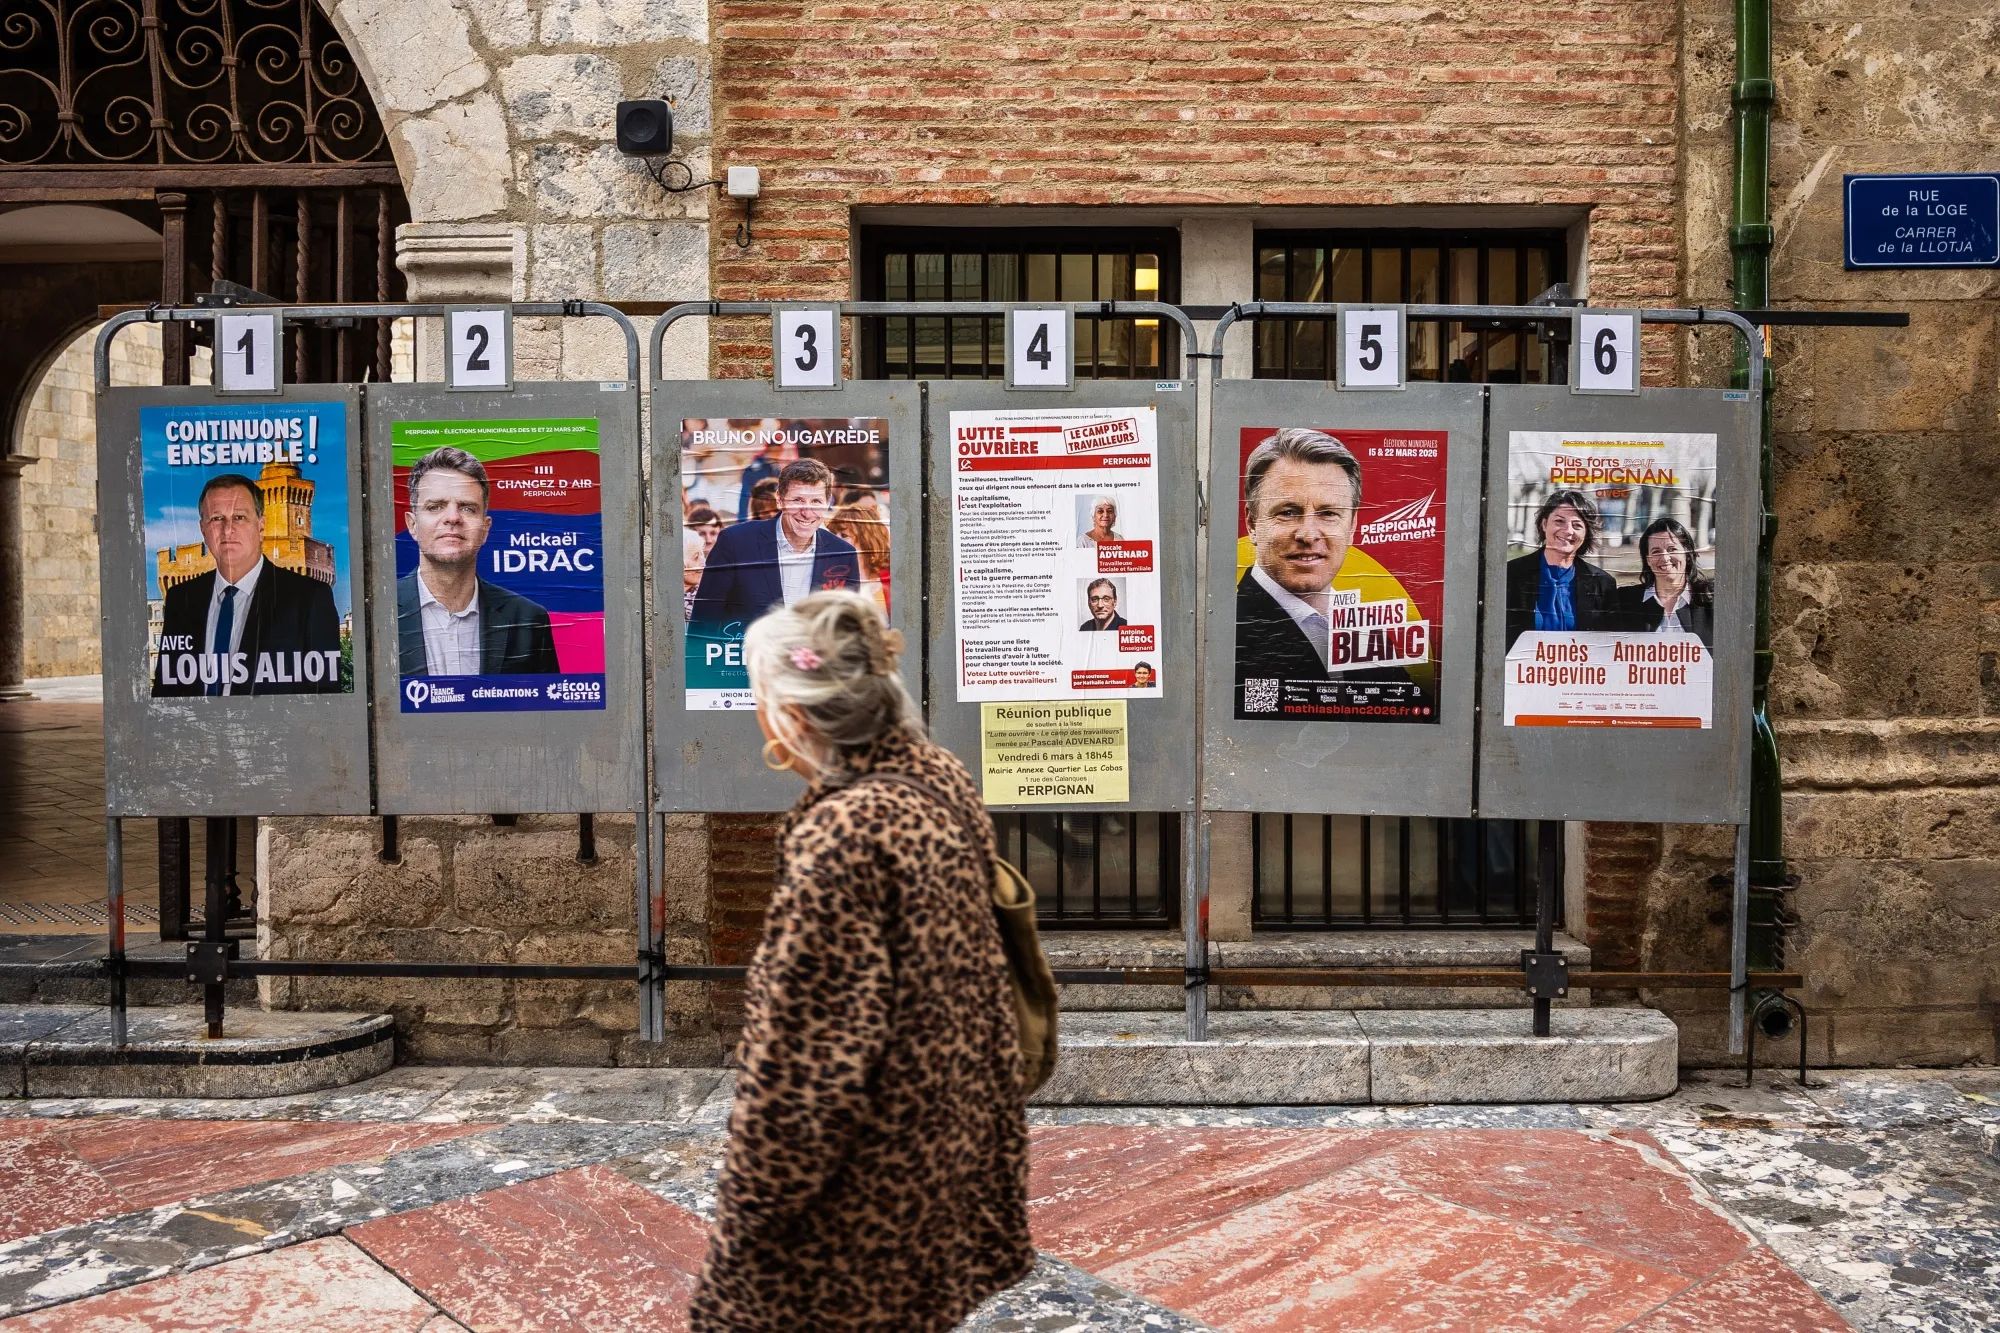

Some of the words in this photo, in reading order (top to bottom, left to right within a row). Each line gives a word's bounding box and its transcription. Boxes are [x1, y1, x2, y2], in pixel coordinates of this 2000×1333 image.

[1909, 190, 1940, 201] RUE
[1882, 205, 1899, 216] de
[1906, 205, 1918, 216] la
[1927, 204, 1968, 216] LOGE
[1895, 227, 1956, 239] CARRER
[1878, 242, 1895, 253] de
[1901, 241, 1913, 253] la
[1919, 241, 1973, 253] LLOTJA
[237, 328, 254, 375] 1
[466, 324, 490, 371] 2
[794, 323, 818, 371] 3
[1026, 323, 1051, 370] 4
[1359, 324, 1383, 371] 5
[1594, 327, 1618, 375] 6
[165, 417, 303, 442] CONTINUONS
[693, 430, 756, 445] BRUNO
[759, 425, 880, 445] NOUGAYRÈDE
[958, 426, 1005, 441] LUTTE
[1070, 429, 1081, 440] LE
[1082, 426, 1110, 438] CAMP
[1112, 421, 1130, 433] DES
[958, 439, 1039, 456] OUVRIÈRE
[1068, 432, 1135, 452] TRAVAILLEURS
[1384, 438, 1408, 448] ÉLECTIONS
[1408, 439, 1438, 448] MUNICIPALES
[167, 441, 303, 465] ENSEMBLE
[1368, 448, 1376, 456] 15
[1378, 448, 1384, 456] &
[1384, 448, 1394, 456] 22
[1396, 448, 1418, 457] MARS
[1419, 449, 1438, 458] 2026
[1102, 456, 1150, 466] PERPIGNAN
[1555, 456, 1582, 468] Plus
[1586, 456, 1620, 468] forts
[1623, 458, 1655, 471] pour
[1550, 468, 1673, 484] PERPIGNAN
[496, 479, 555, 489] CHANGEZ
[1595, 488, 1630, 499] avec
[1360, 516, 1436, 535] PERPIGNAN
[510, 532, 577, 547] Mickaël
[1360, 528, 1436, 545] Autrement
[493, 548, 595, 573] IDRAC
[1098, 550, 1148, 559] ADVENARD
[1333, 593, 1356, 606] AVEC
[1332, 604, 1404, 630] MATHIAS
[162, 635, 194, 650] AVEC
[1120, 634, 1153, 644] MÉROC
[1332, 625, 1425, 666] BLANC
[1535, 638, 1588, 664] Agnès
[1614, 641, 1701, 663] Annabelle
[161, 652, 249, 685] LOUIS
[255, 650, 342, 683] ALIOT
[1517, 663, 1606, 686] Langevine
[1628, 663, 1687, 686] Brunet
[430, 687, 455, 696] FRANCE
[562, 679, 600, 692] ÉCOLO
[430, 694, 466, 704] INSOUMISE
[562, 692, 600, 700] GISTES
[996, 708, 1051, 719] Réunion
[1055, 706, 1112, 720] publique
[1284, 704, 1410, 715] mathiasblanc2026.fr
[1031, 738, 1063, 746] Pascale
[1065, 737, 1114, 746] ADVENARD
[998, 752, 1040, 762] Vendredi
[1042, 752, 1048, 762] 6
[1050, 753, 1074, 761] mars
[1076, 752, 1082, 760] à
[1085, 751, 1113, 760] 18h45
[1016, 766, 1044, 774] Annexe
[1047, 765, 1081, 774] Quartier
[1084, 764, 1098, 772] Las
[1054, 775, 1088, 784] Calanques
[1018, 784, 1094, 796] PERPIGNAN
